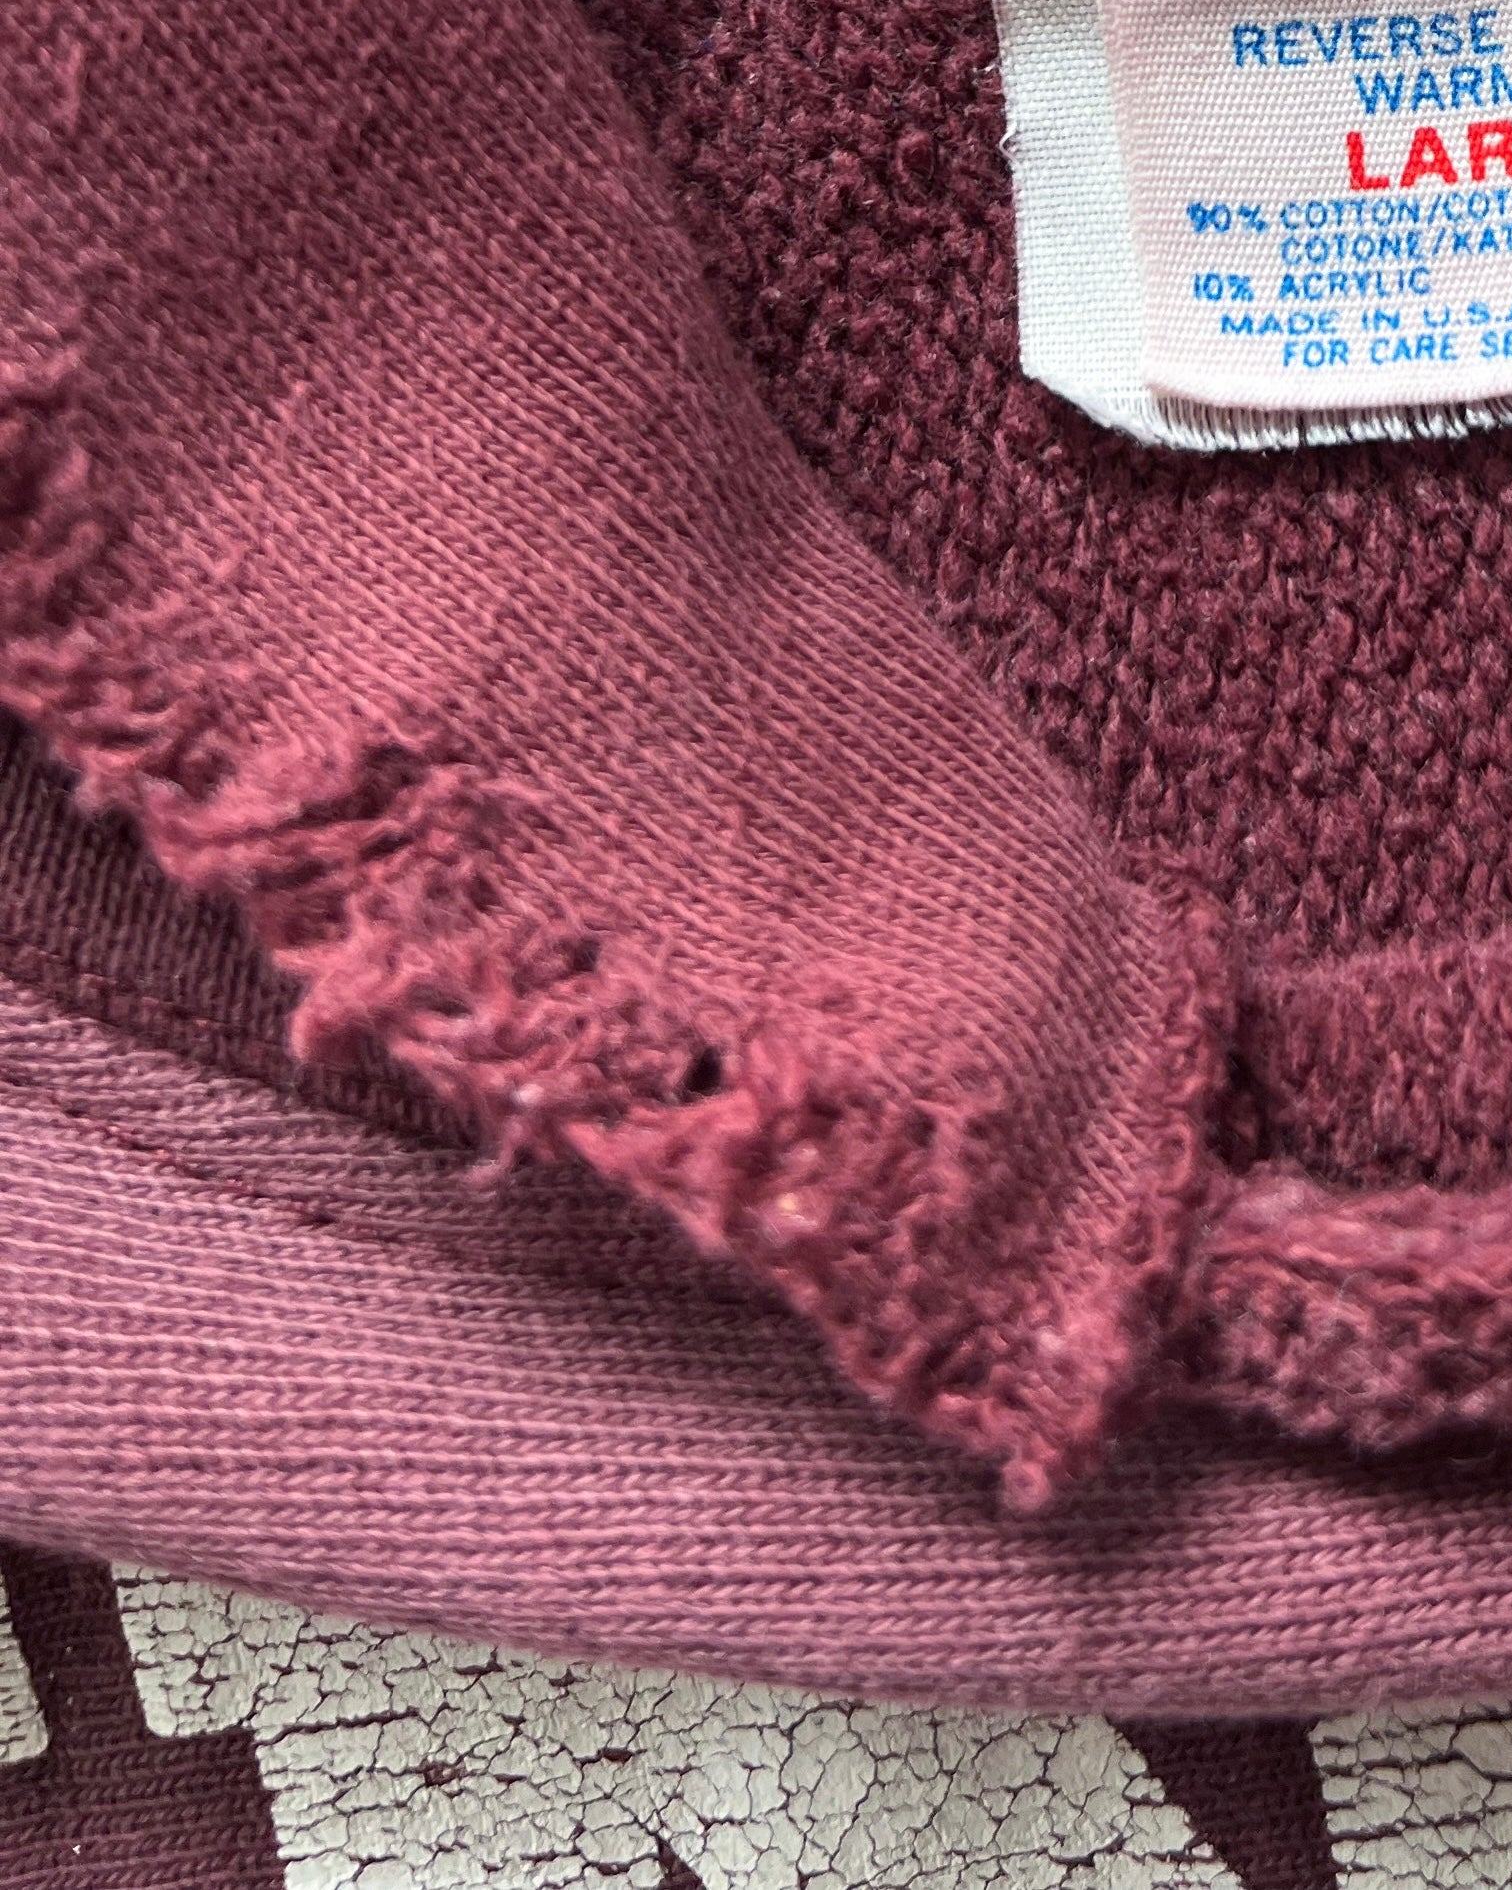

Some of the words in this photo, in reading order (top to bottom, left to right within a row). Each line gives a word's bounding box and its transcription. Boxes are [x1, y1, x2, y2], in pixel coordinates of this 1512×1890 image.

[1232, 9, 1504, 67] REVERSE
[1186, 200, 1269, 235] 90%
[1192, 272, 1255, 303] 10%
[1278, 265, 1433, 302] ACRYLIC
[1219, 308, 1341, 337] MADE
[1361, 308, 1402, 332] IN
[1282, 338, 1350, 369] FOR
[1369, 331, 1460, 366] CARE
